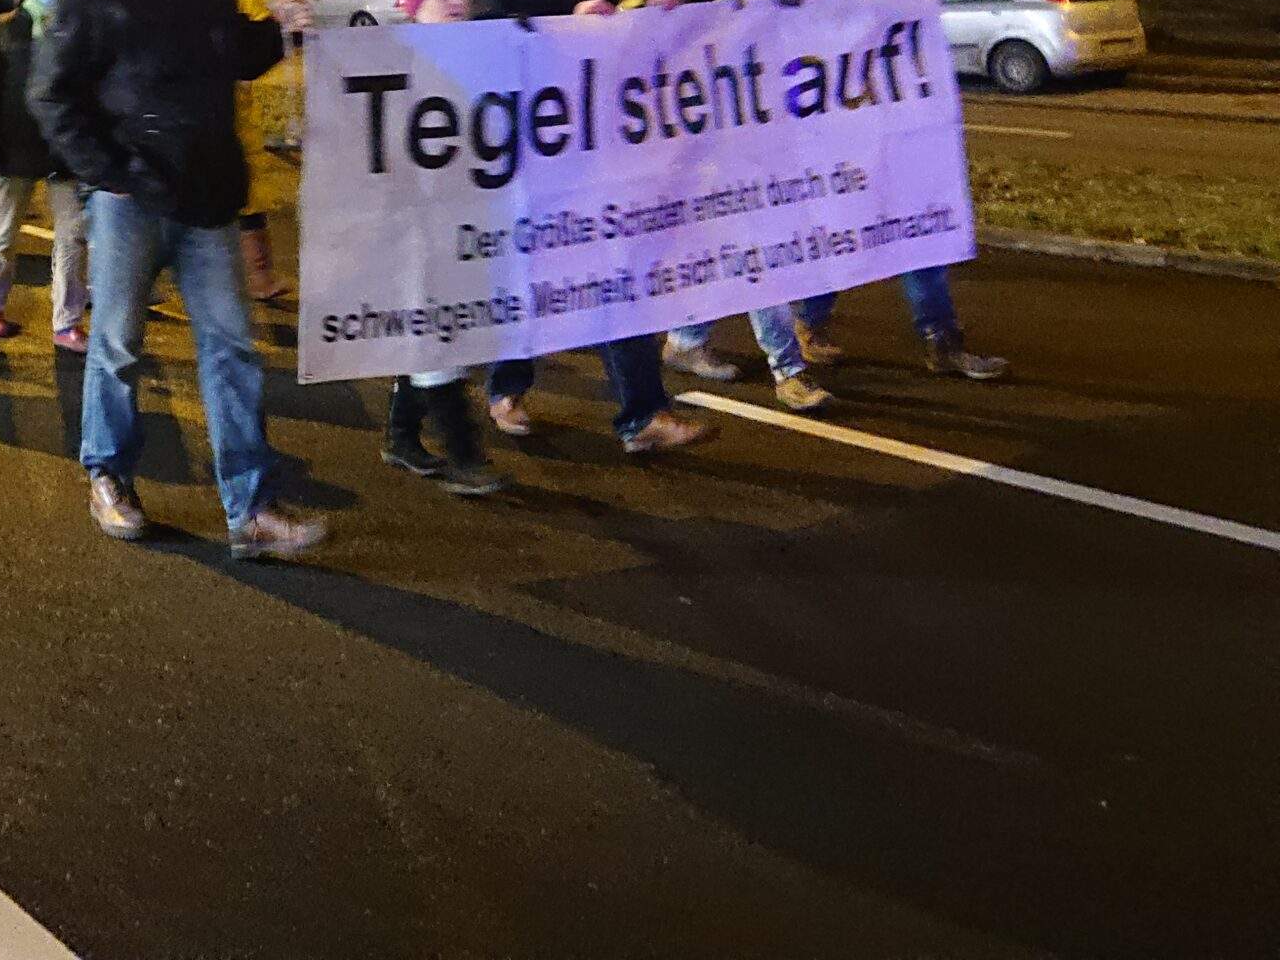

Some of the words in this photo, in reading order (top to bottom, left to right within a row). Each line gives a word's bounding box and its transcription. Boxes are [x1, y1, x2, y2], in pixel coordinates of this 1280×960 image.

[342, 58, 596, 189] Tegel
[621, 43, 772, 144] steht
[782, 19, 931, 118] auf!
[458, 224, 507, 261] Der
[601, 194, 687, 240] Schaden
[767, 167, 827, 207] durch
[830, 161, 869, 195] die
[322, 288, 521, 343] schweigende
[644, 259, 675, 298] die
[675, 248, 718, 290] sich
[763, 231, 805, 269] und
[805, 225, 857, 260] alles
